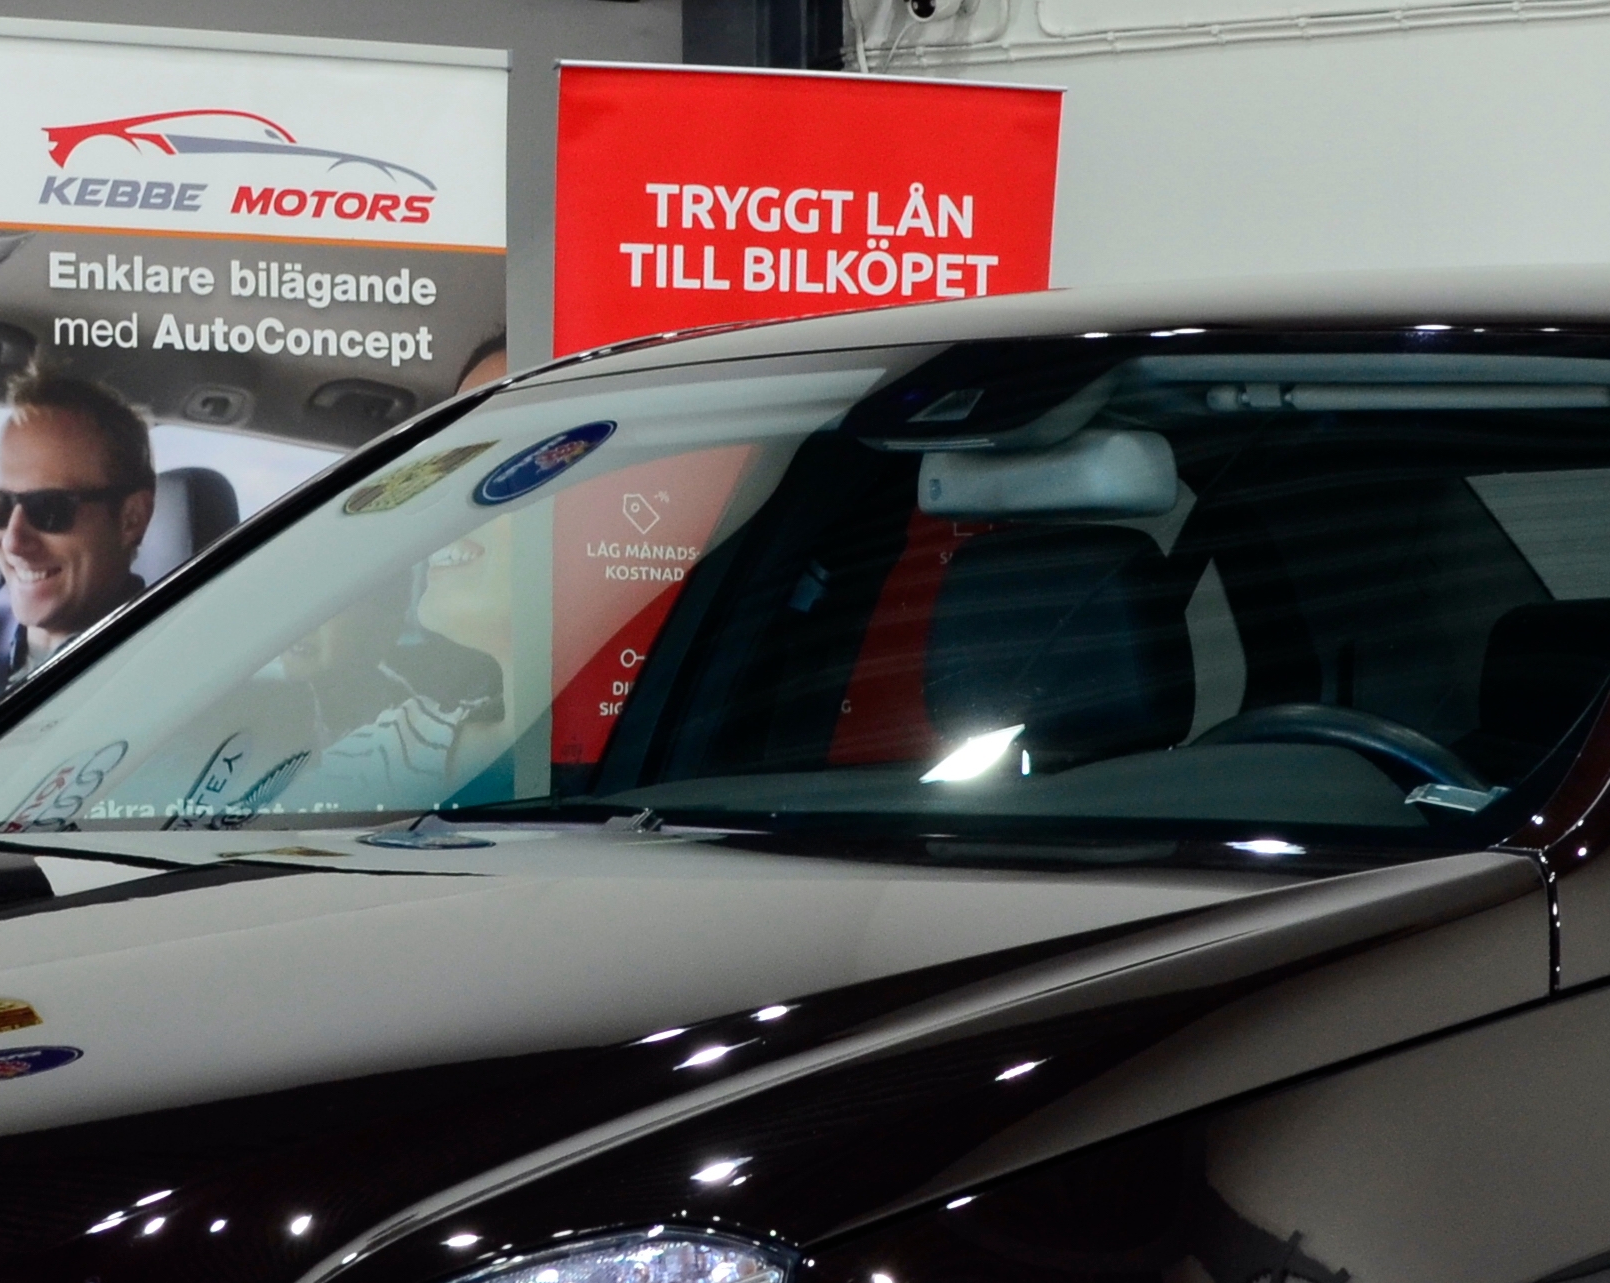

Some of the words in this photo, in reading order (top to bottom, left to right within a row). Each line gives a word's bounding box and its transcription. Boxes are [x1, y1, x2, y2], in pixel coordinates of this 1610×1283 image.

[38, 176, 208, 212] KEBBE
[230, 185, 436, 224] MOTORS
[646, 182, 853, 234] TRYGGT
[867, 181, 974, 239] LÅN
[49, 251, 214, 296] Enklare
[230, 259, 437, 307] bilägande
[620, 242, 729, 290] TILL
[743, 239, 999, 299] BILKÖPET
[53, 313, 138, 350] med
[152, 313, 433, 366] AutoConcept
[587, 541, 620, 558] LÅG
[605, 565, 684, 581] KOSTNAD
